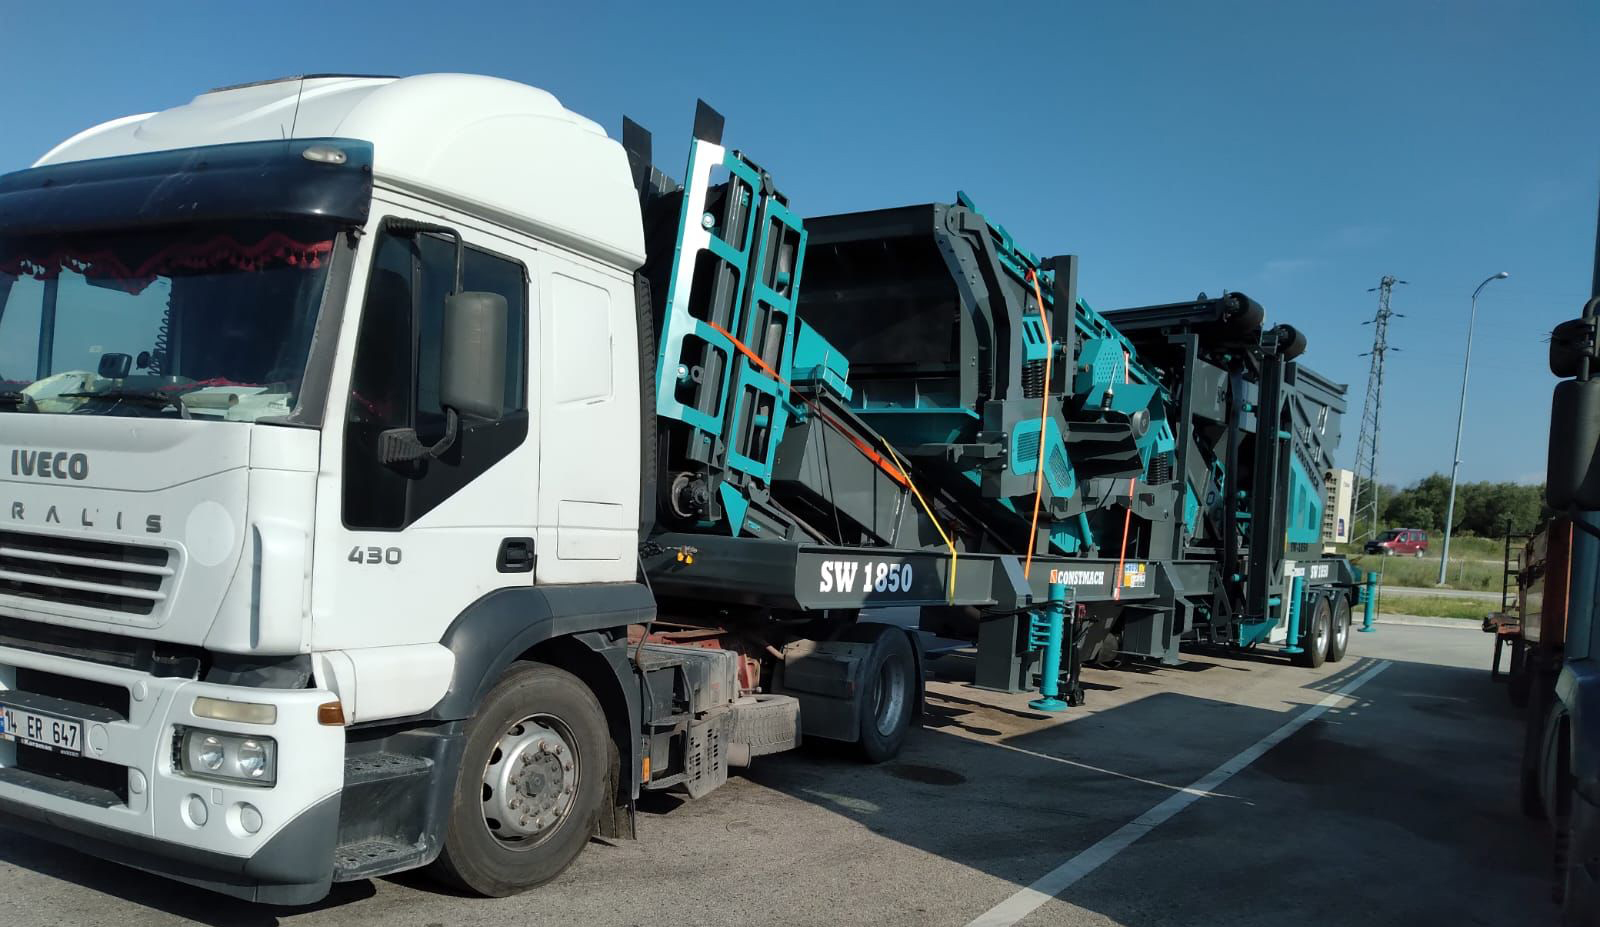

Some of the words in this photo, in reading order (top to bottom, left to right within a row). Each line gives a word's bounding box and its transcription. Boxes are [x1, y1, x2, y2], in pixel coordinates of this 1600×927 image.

[11, 449, 89, 480] IVECO
[347, 545, 402, 565] 430
[819, 560, 858, 593] SW
[863, 562, 913, 593] 1850
[1057, 570, 1105, 585] CONSTMACH
[5, 709, 18, 733] 14
[27, 715, 43, 741] ER
[52, 721, 77, 747] 647
